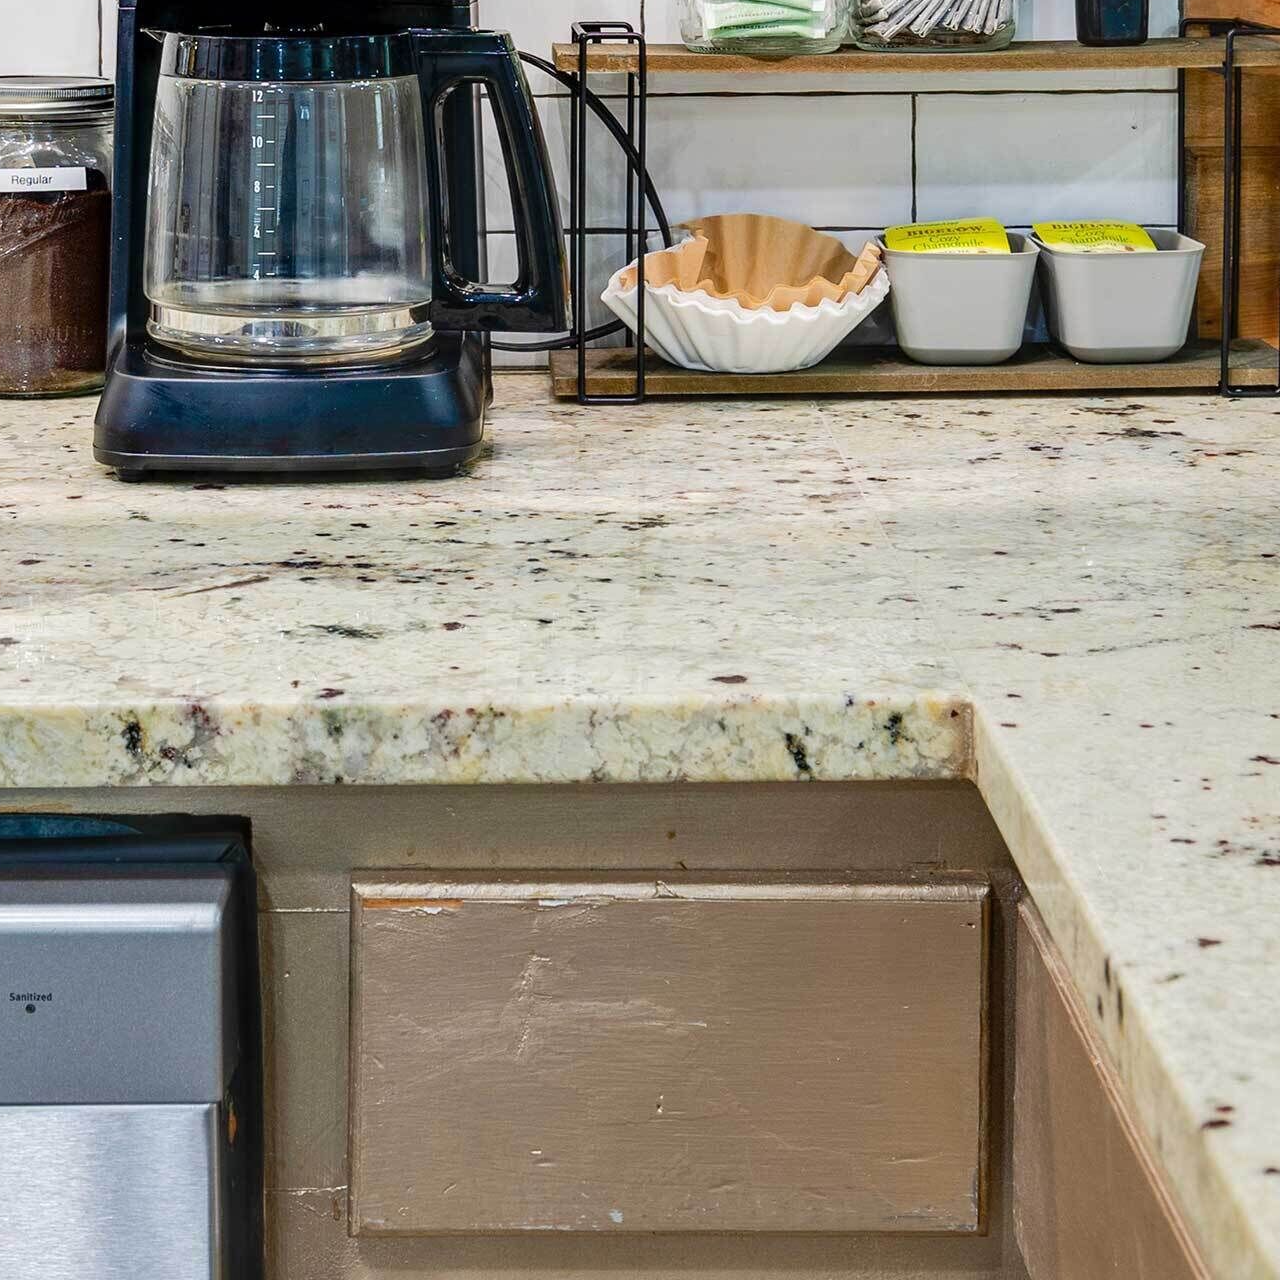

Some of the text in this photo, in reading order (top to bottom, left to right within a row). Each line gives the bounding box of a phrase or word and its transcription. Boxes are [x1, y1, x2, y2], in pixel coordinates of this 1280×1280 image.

[252, 90, 263, 102] 12
[252, 136, 263, 148] 10
[11, 173, 53, 187] Regular
[254, 181, 261, 193] 8
[253, 225, 261, 238] 6
[907, 226, 986, 237] BIGELOW
[913, 238, 984, 252] Chamomile
[929, 235, 961, 244] Cozy
[253, 270, 260, 280] 4
[9, 992, 53, 1002] Sanitized
